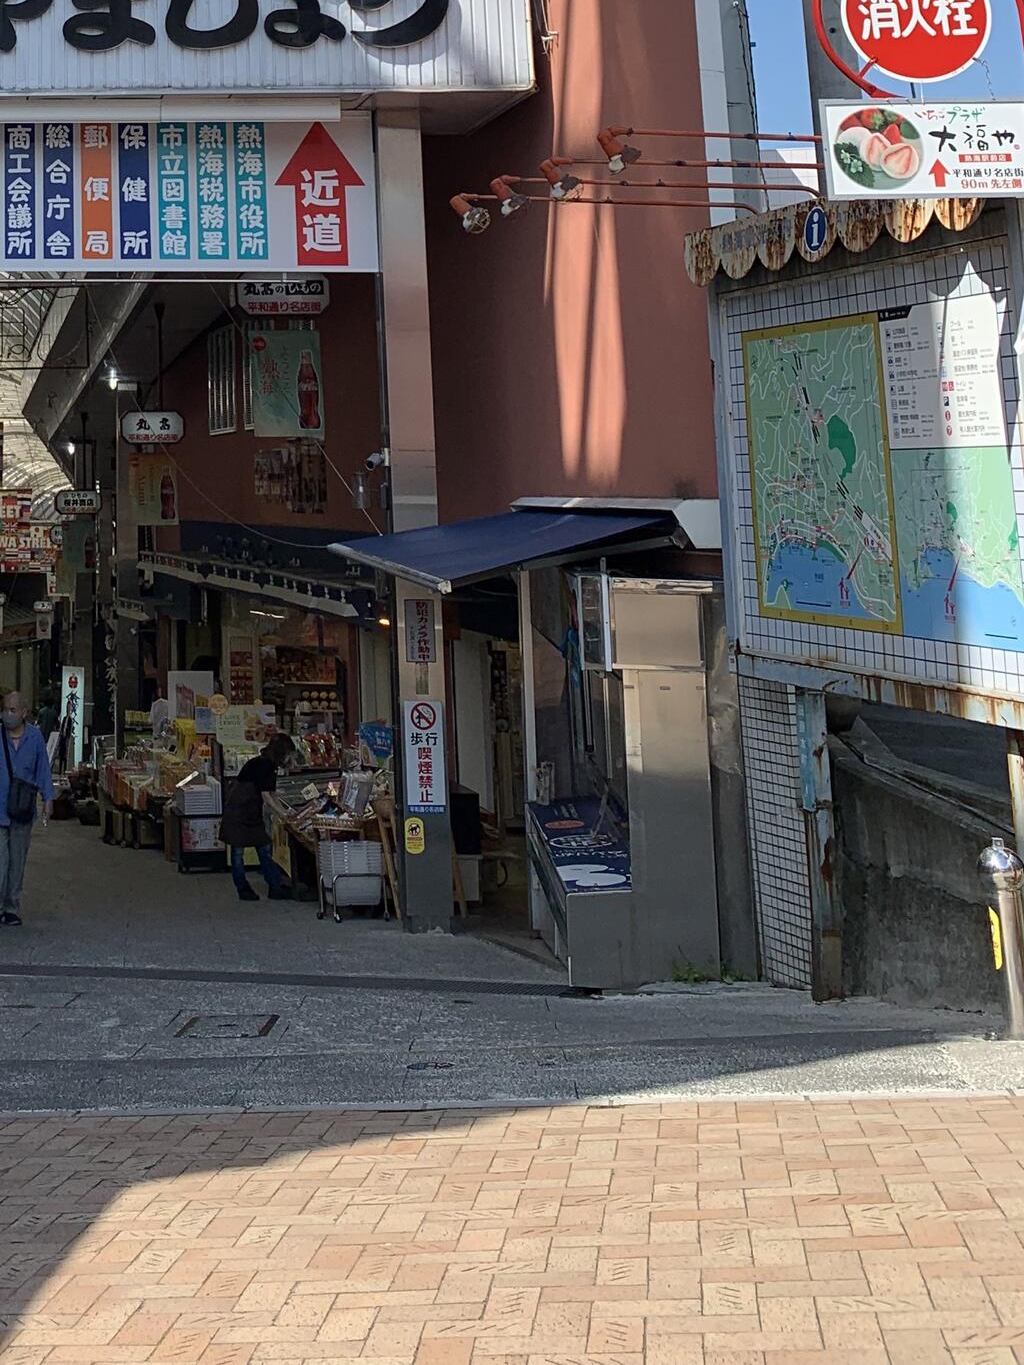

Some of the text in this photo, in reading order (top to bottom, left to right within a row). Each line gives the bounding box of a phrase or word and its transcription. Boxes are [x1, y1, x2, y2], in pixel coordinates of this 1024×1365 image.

[7, 124, 33, 256] 商工会議所
[45, 124, 71, 256] 総合庁舎
[84, 124, 110, 255] 郵便局
[121, 124, 148, 255] 保健所
[160, 124, 187, 256] 市立図書館
[198, 124, 225, 256] 熱海税務署
[237, 124, 266, 256] 熱海市役所
[928, 125, 1015, 152] 大福や
[300, 168, 343, 254] 近道
[248, 301, 321, 313] 平和通り名店街
[410, 732, 438, 746] 歩行
[418, 747, 434, 803] 喫煙禁止
